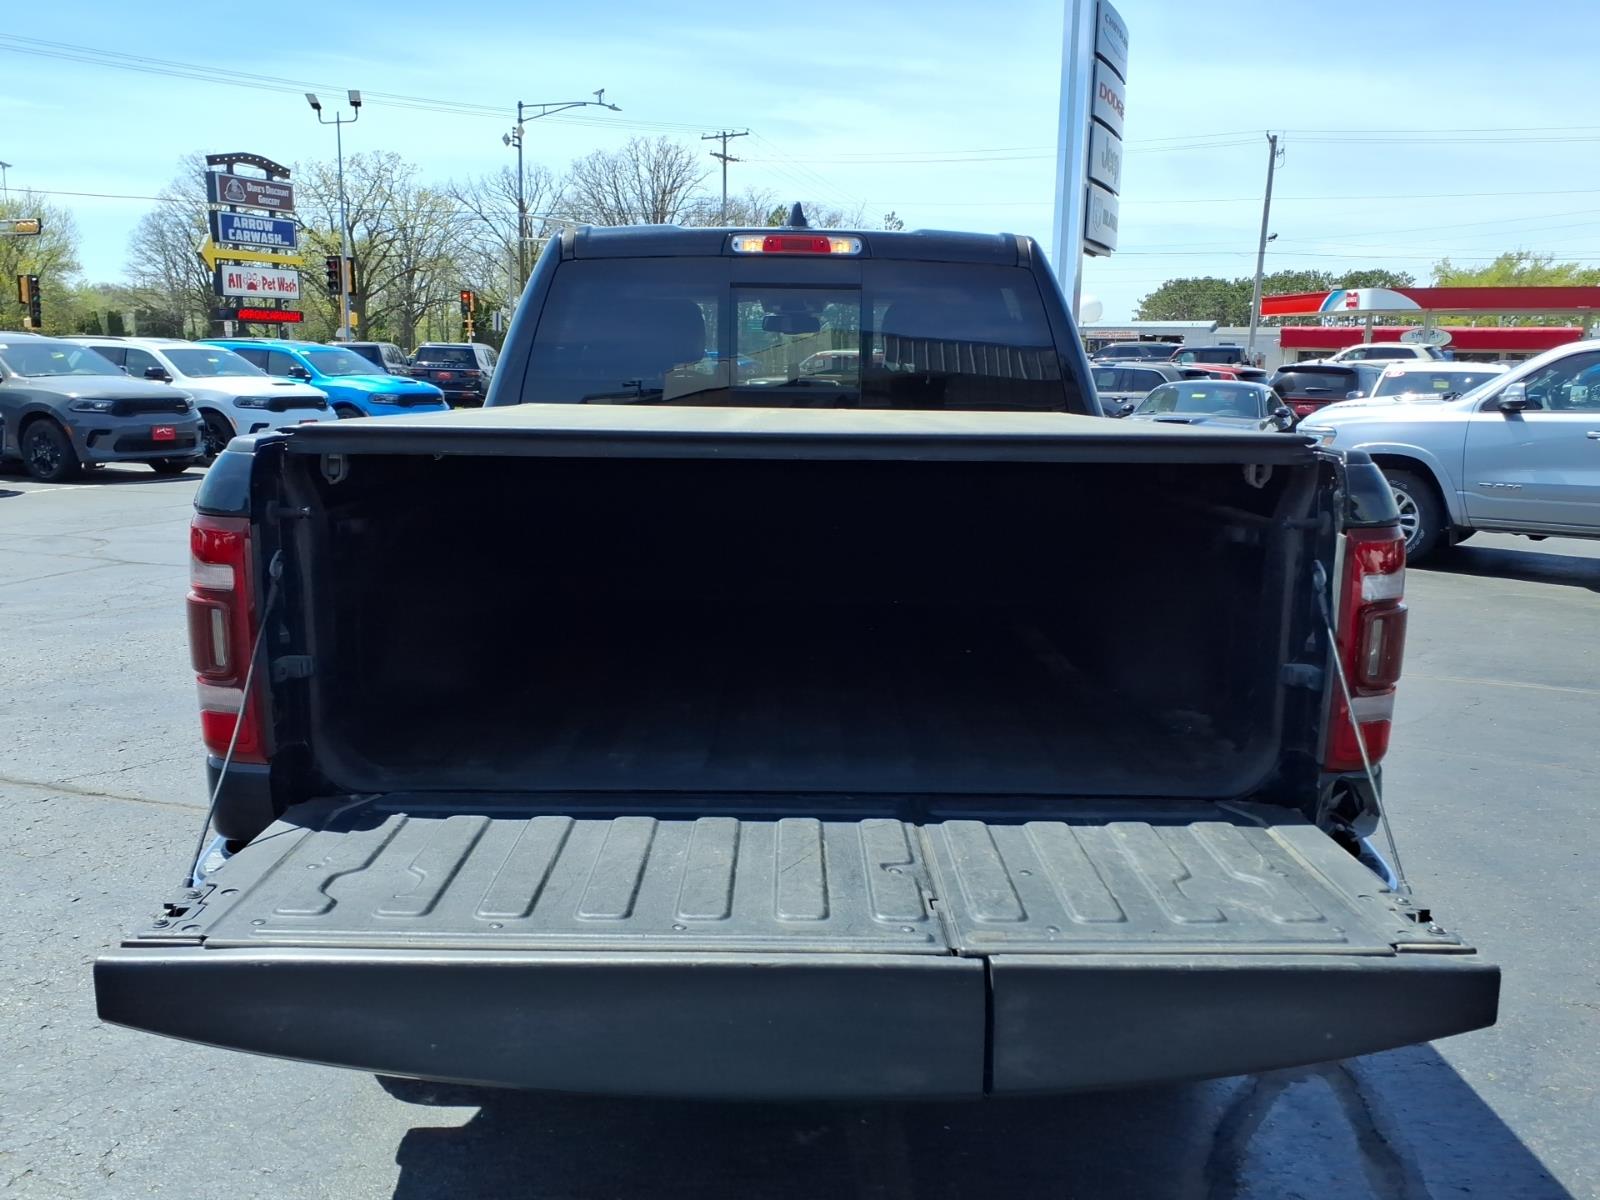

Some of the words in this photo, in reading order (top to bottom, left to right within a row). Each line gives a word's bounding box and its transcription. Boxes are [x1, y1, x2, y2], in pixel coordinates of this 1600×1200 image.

[233, 216, 274, 232] ARROW
[228, 272, 243, 289] All
[261, 275, 277, 291] Pet
[277, 276, 297, 293] Wash
